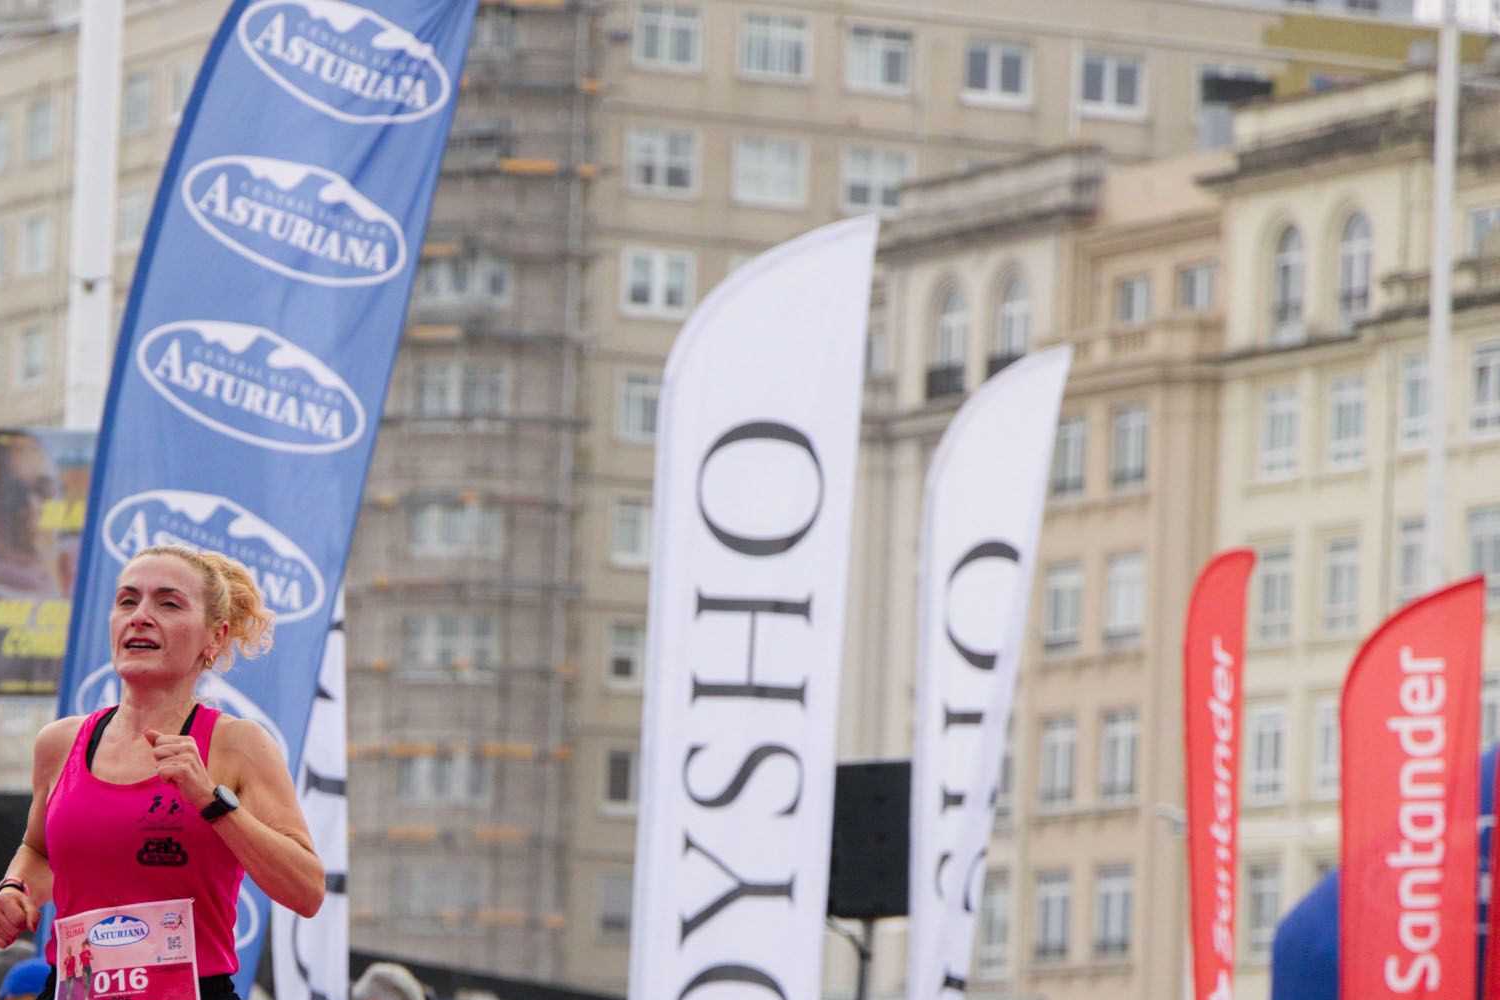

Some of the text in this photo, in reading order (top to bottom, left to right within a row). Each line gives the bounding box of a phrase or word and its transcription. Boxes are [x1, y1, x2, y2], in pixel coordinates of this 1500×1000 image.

[197, 171, 388, 272] ASTURIANA
[153, 338, 344, 441] ASTURIANA
[1384, 646, 1446, 993] Santander
[92, 927, 146, 941] ASTURIANA
[93, 967, 149, 993] 016
